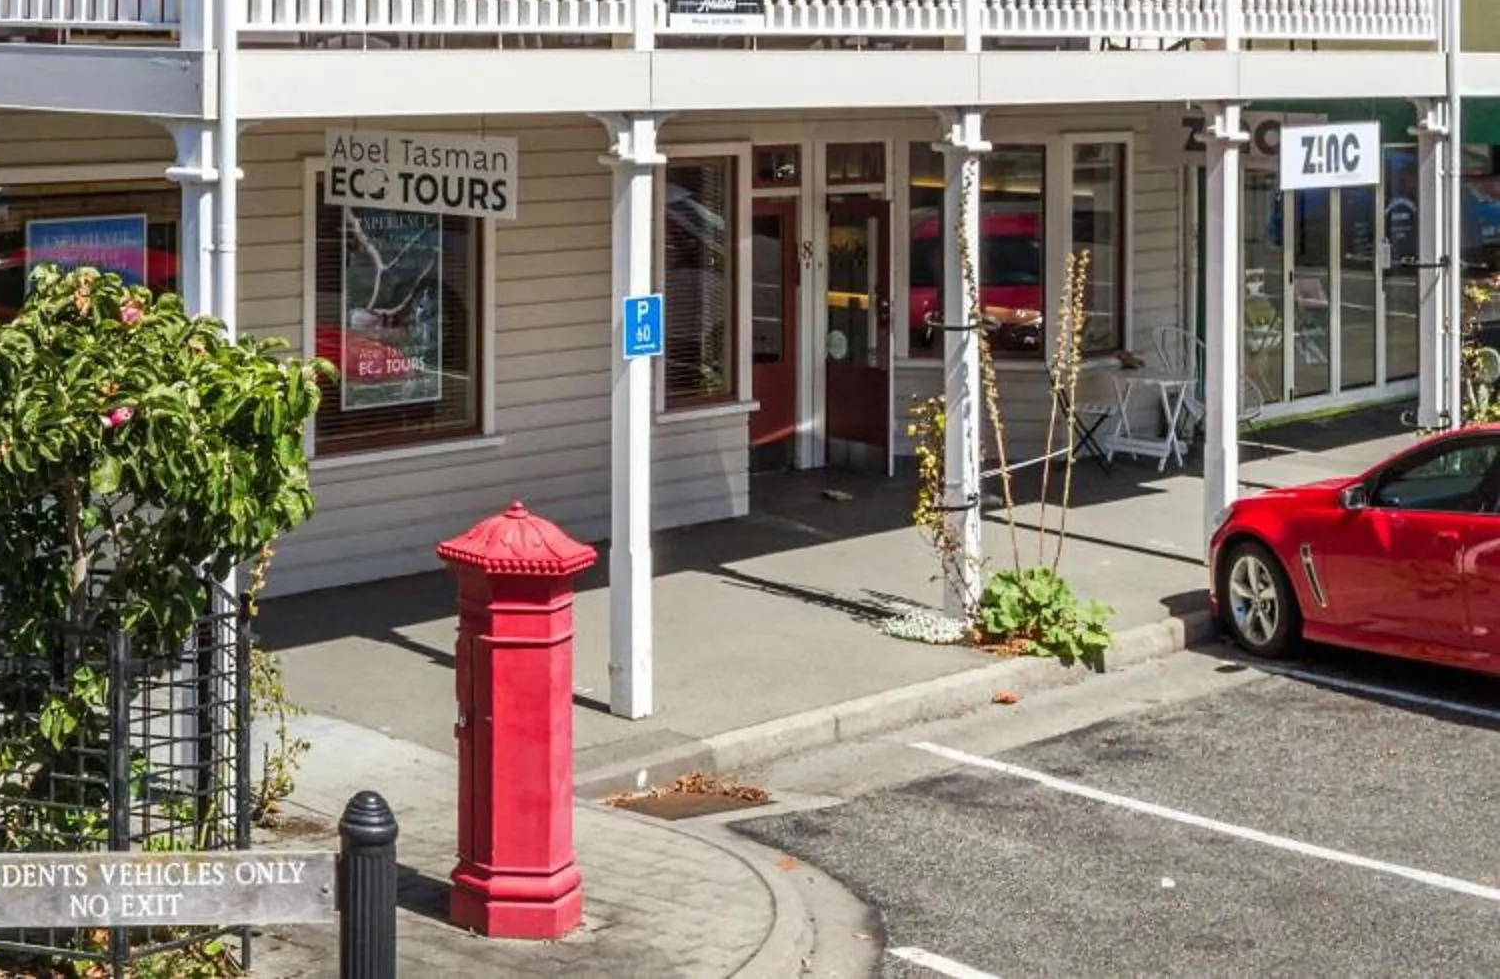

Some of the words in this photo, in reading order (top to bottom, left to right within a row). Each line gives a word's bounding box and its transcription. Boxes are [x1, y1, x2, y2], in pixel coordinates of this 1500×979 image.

[331, 135, 389, 164] Abel
[399, 139, 508, 173] Tasman
[398, 172, 507, 211] TOURS
[637, 300, 649, 323] P
[636, 324, 651, 342] 60
[385, 356, 425, 373] TOURS
[100, 862, 225, 886] VEHICLES
[235, 861, 305, 885] ONLY
[70, 894, 108, 918] NO
[121, 893, 183, 917] EXIT
